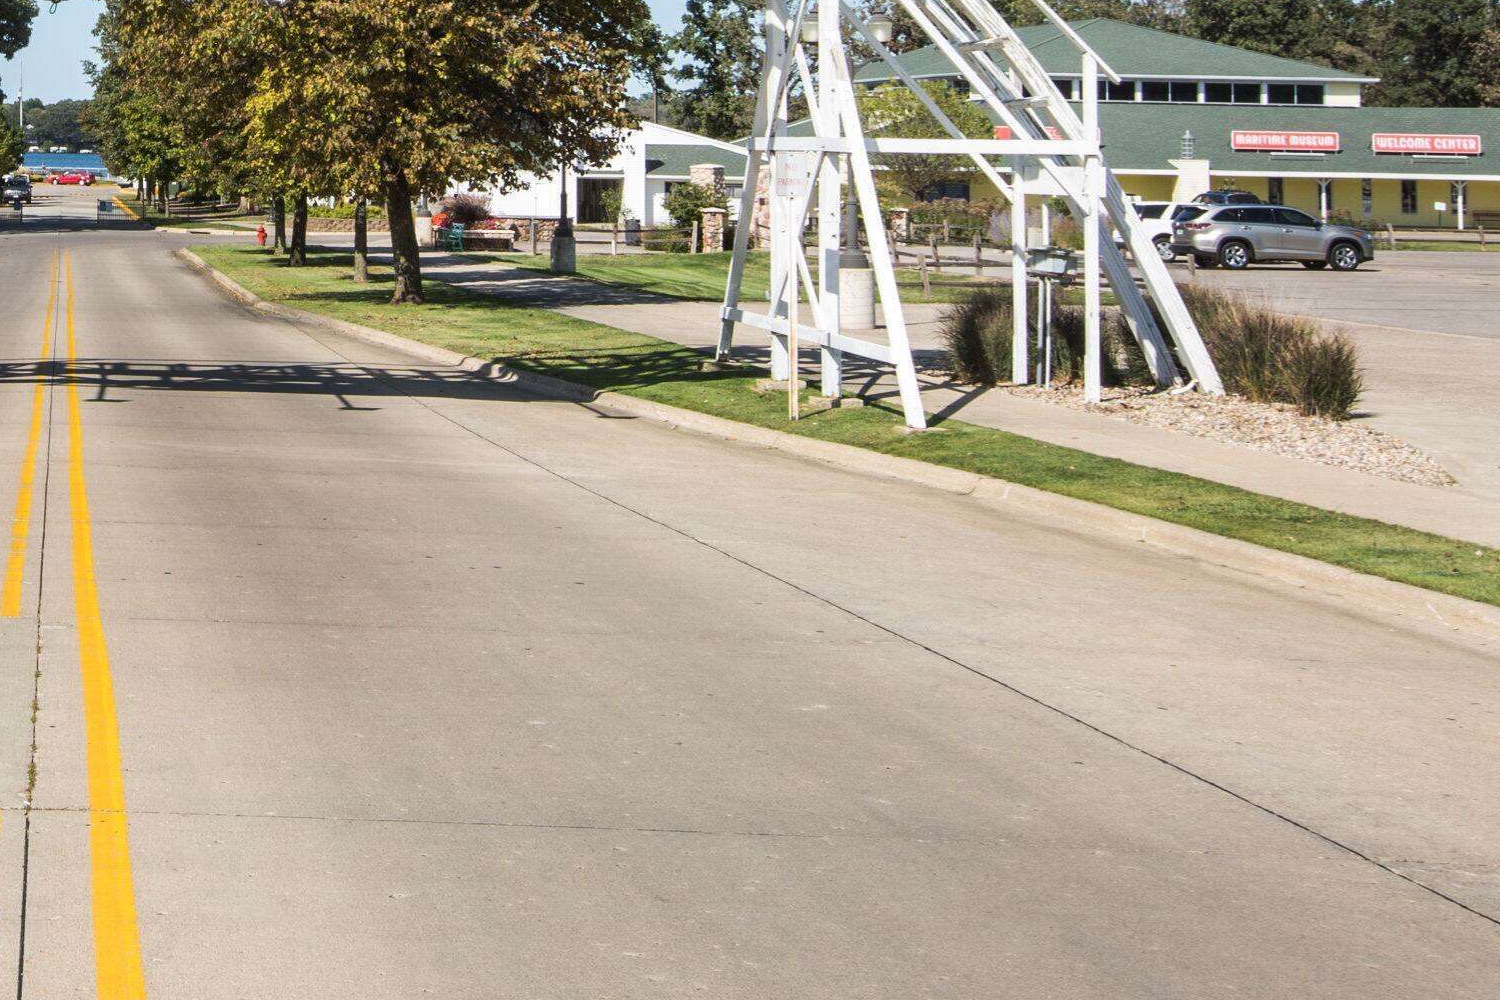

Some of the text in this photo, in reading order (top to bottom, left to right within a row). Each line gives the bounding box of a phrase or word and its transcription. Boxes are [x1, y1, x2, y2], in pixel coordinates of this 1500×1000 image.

[1235, 134, 1335, 146] MARITIME MUSEUM
[1376, 137, 1477, 150] WELCOME CENTER
